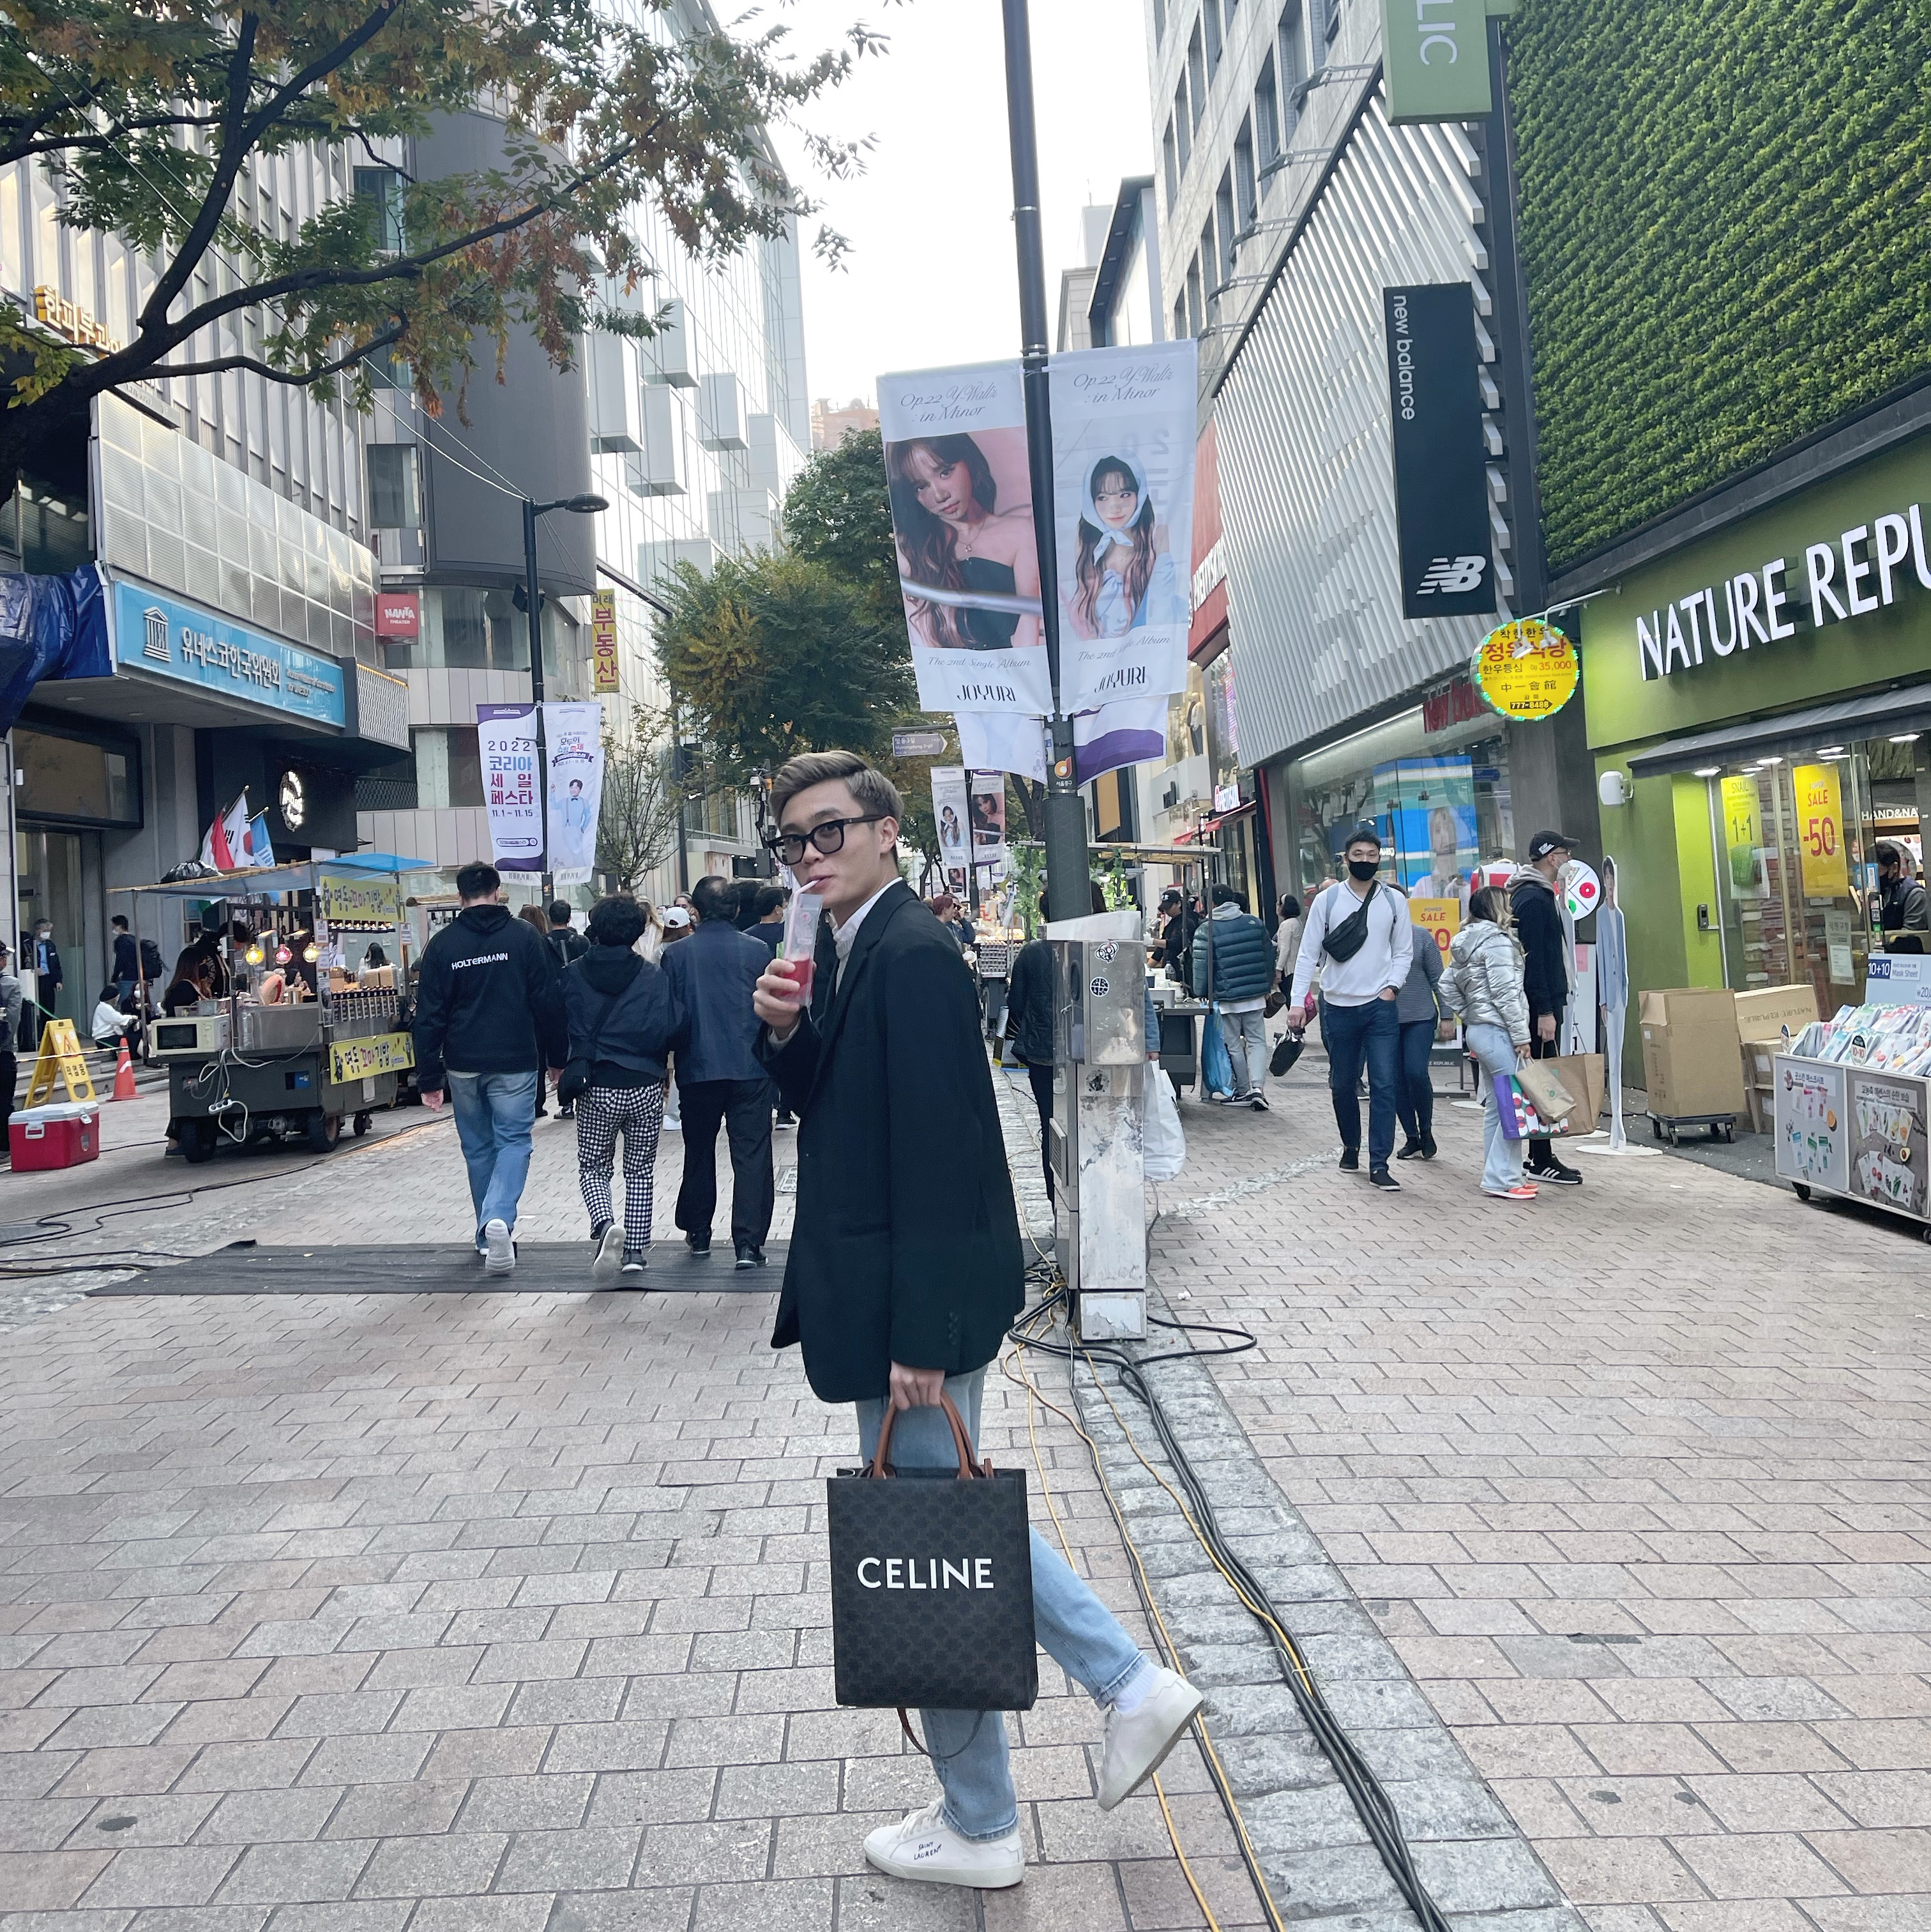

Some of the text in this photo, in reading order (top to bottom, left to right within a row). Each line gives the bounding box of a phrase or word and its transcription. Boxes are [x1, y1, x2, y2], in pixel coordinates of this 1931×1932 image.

[1393, 295, 1415, 420] new balance
[1074, 374, 1116, 391] Op.22
[900, 393, 943, 409] Op.22
[1110, 386, 1161, 401] Minor
[939, 406, 985, 420] Minor
[592, 593, 614, 605] 미래
[384, 606, 415, 618] NANTA
[1636, 558, 1795, 681] NATURE
[593, 608, 619, 683] 부동산
[1077, 635, 1170, 661] The 2nd Album
[181, 627, 281, 691] 유네스코한국위원회
[928, 657, 1031, 669] The 2nd Single Album
[1483, 663, 1523, 674] 한우등심
[1539, 660, 1571, 671] 35,000
[1094, 666, 1146, 694] JOYURI
[957, 684, 1017, 702] JOYURI
[488, 740, 531, 752] 2022
[489, 756, 533, 771] 코리아
[490, 791, 534, 805] 페스타
[1807, 789, 1829, 807] SALE
[1732, 814, 1753, 842] 1+1
[1803, 816, 1836, 857] -50
[1420, 912, 1446, 922] SALE
[451, 952, 508, 970] HOLTERMANN
[1867, 962, 1890, 977] 10+10
[1892, 969, 1904, 977] Mask
[1904, 970, 1918, 978] Sheet
[857, 1556, 994, 1589] CELINE
[914, 1844, 942, 1860] LAURENT
